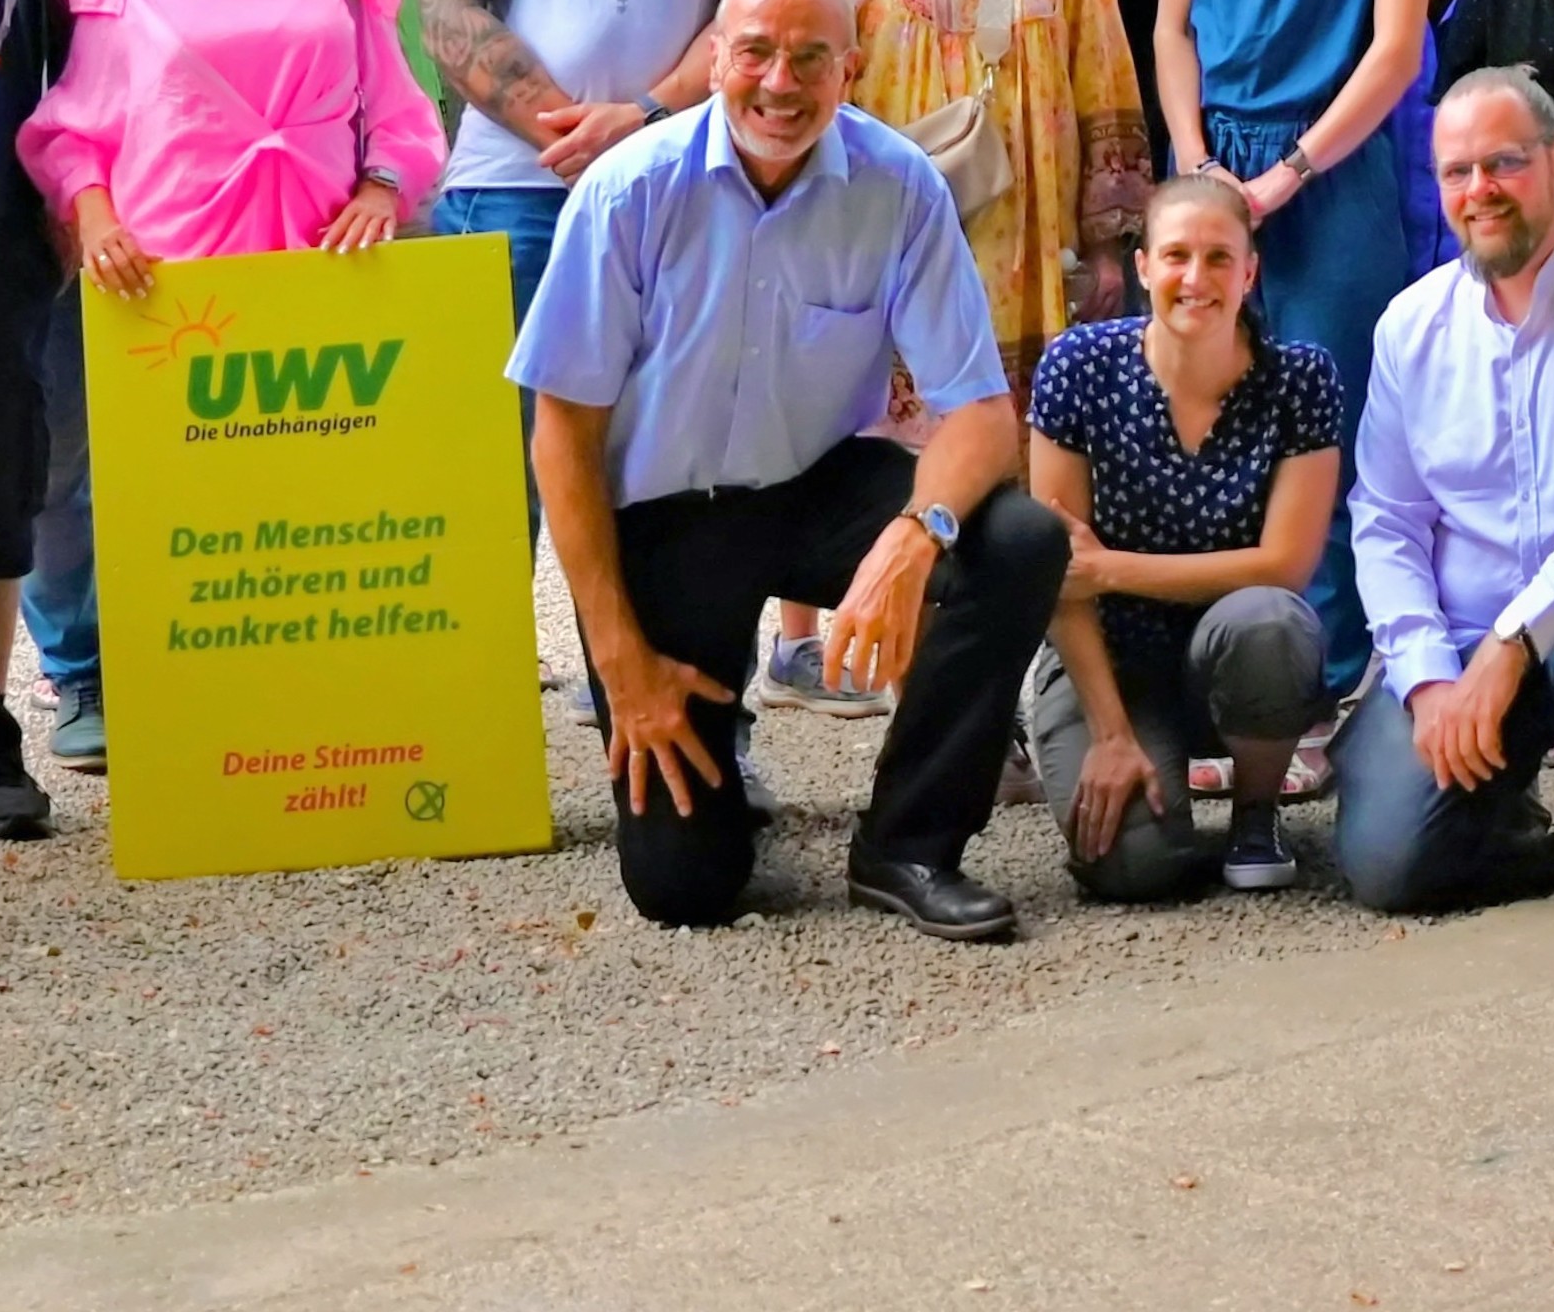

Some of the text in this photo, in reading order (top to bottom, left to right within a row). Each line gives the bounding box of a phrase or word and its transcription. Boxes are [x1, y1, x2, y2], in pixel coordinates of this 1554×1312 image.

[187, 339, 405, 420] UWV
[185, 413, 376, 442] Die Unabhängigen
[170, 510, 447, 558] Den Menschen
[190, 554, 432, 603] zuhören und
[168, 603, 460, 651] konkret helfen.
[223, 743, 424, 776] Deine Stimme
[284, 784, 367, 813] zählt!
